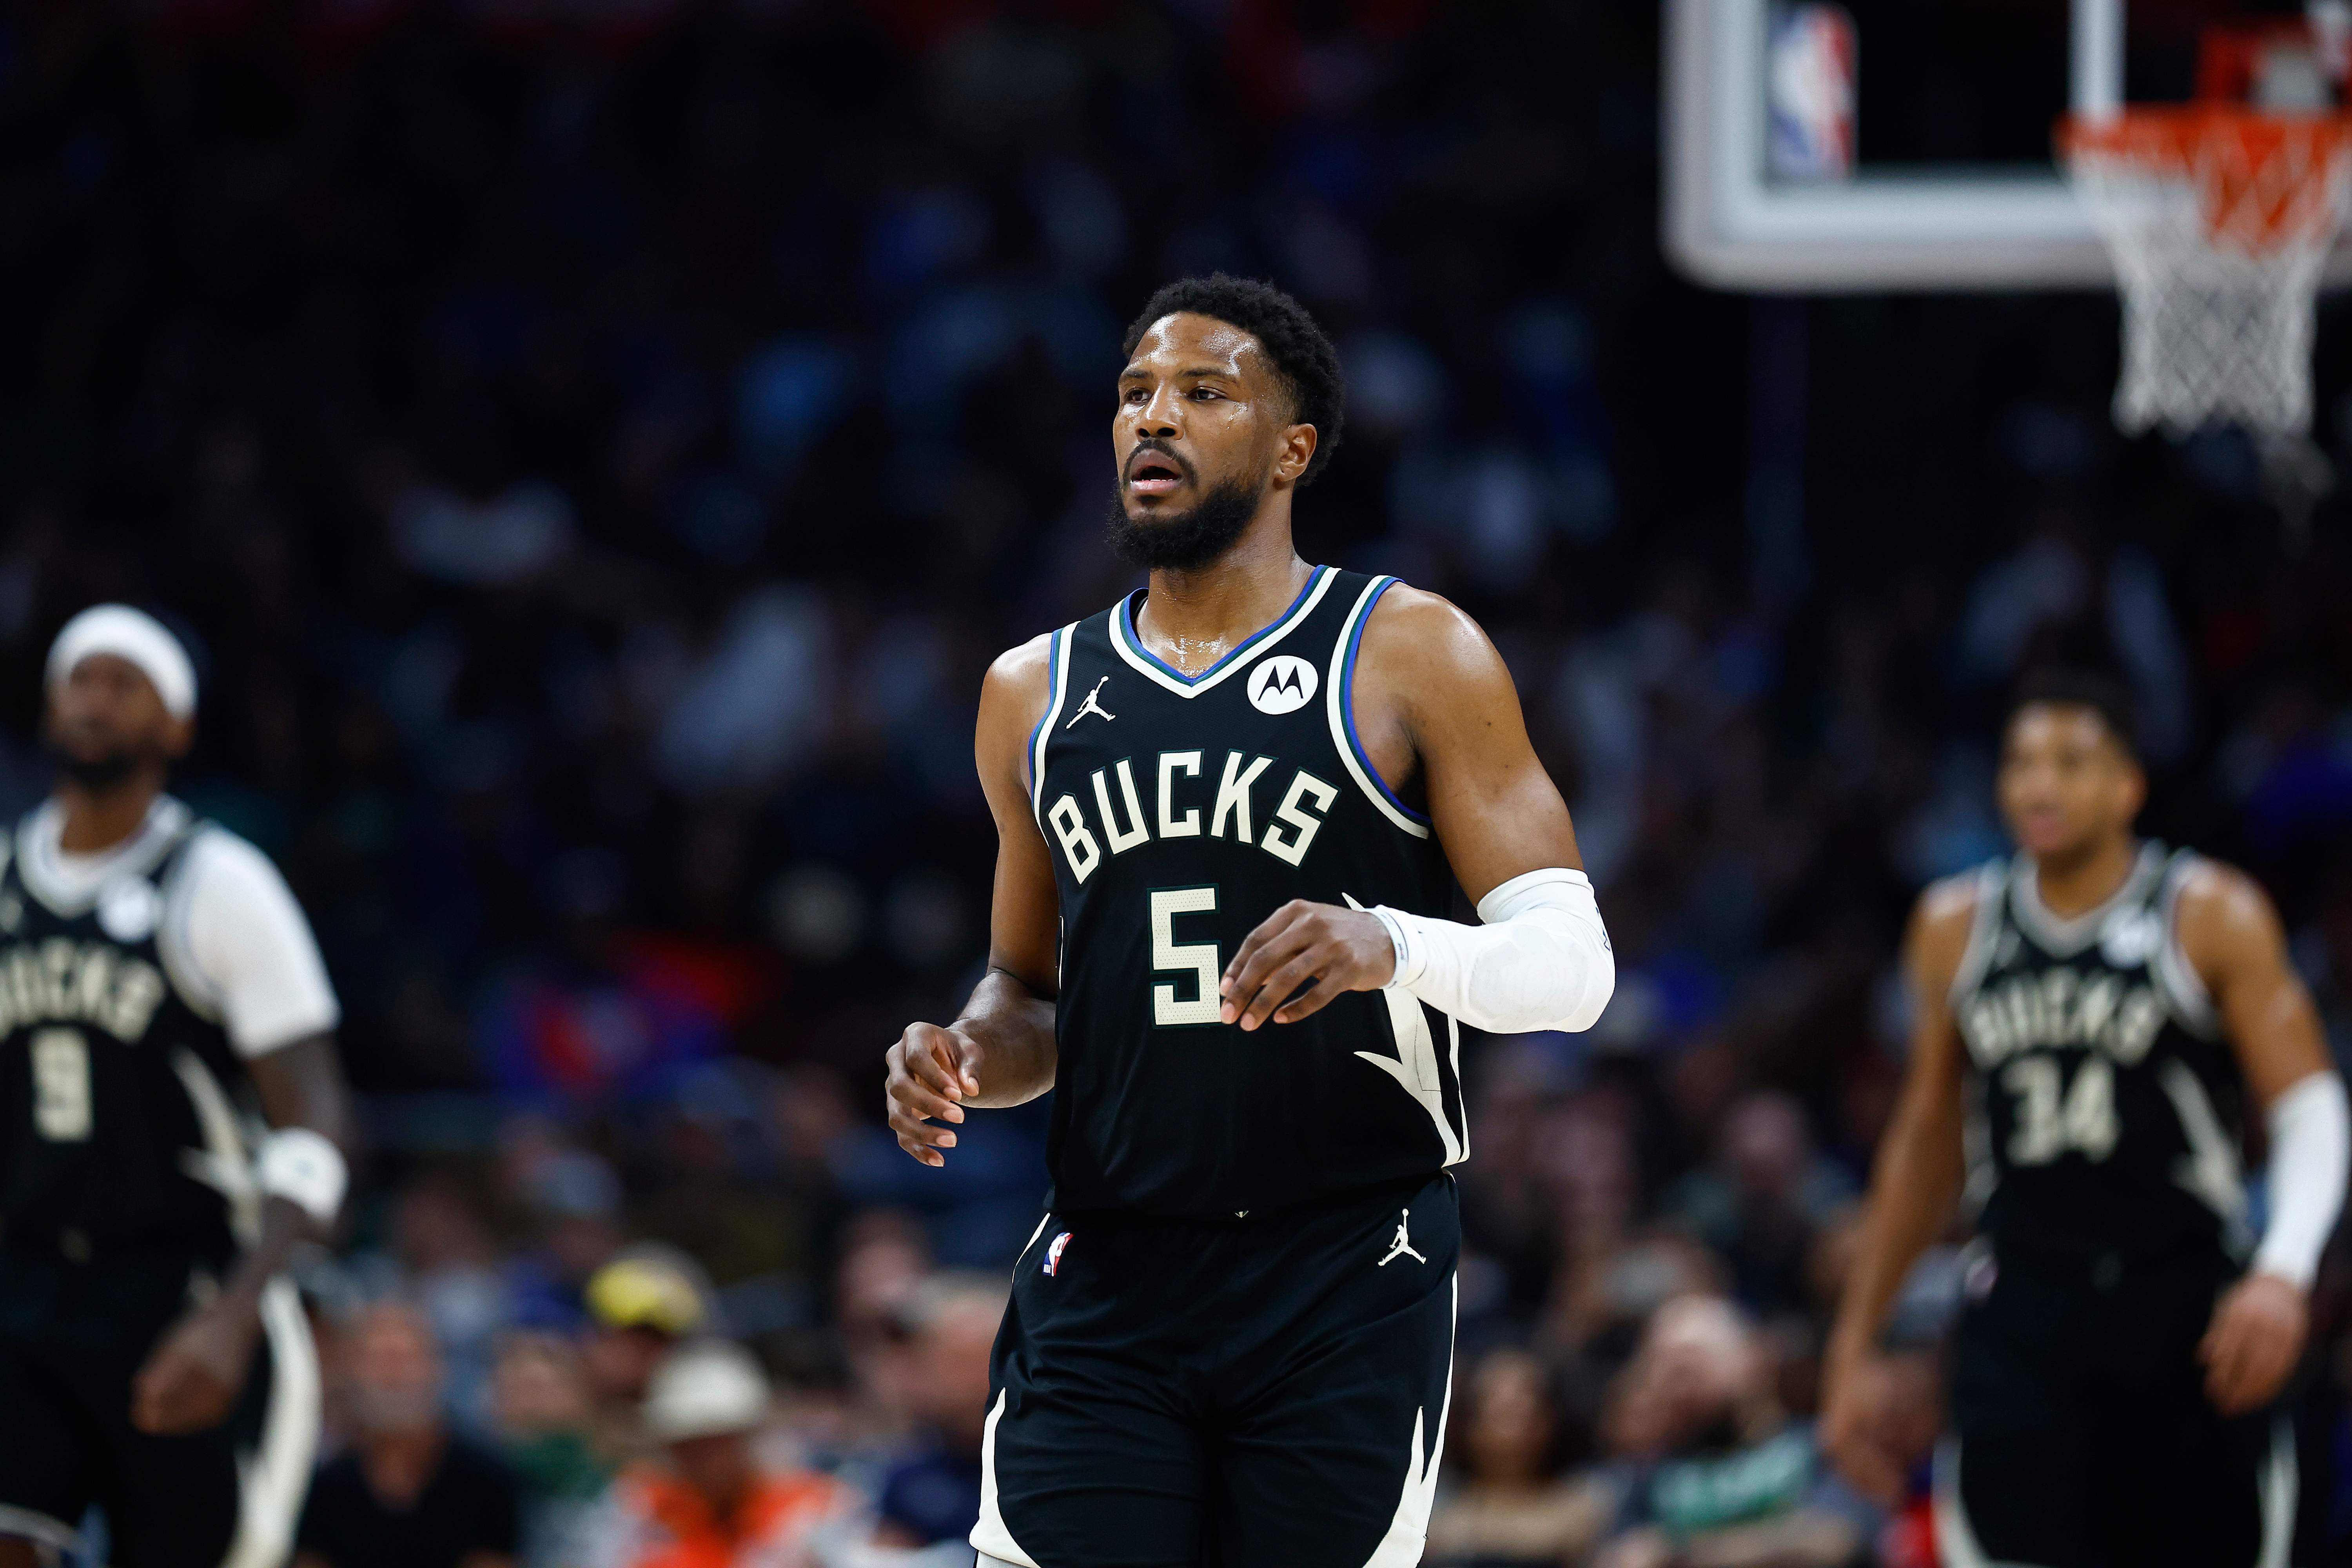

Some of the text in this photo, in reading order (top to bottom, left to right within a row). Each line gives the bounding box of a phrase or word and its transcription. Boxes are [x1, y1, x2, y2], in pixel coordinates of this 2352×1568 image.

[1047, 748, 1341, 885] BUCKS
[1149, 886, 1222, 1027] 5
[1961, 965, 2166, 1069] BUCKS
[2001, 1054, 2120, 1166] 34
